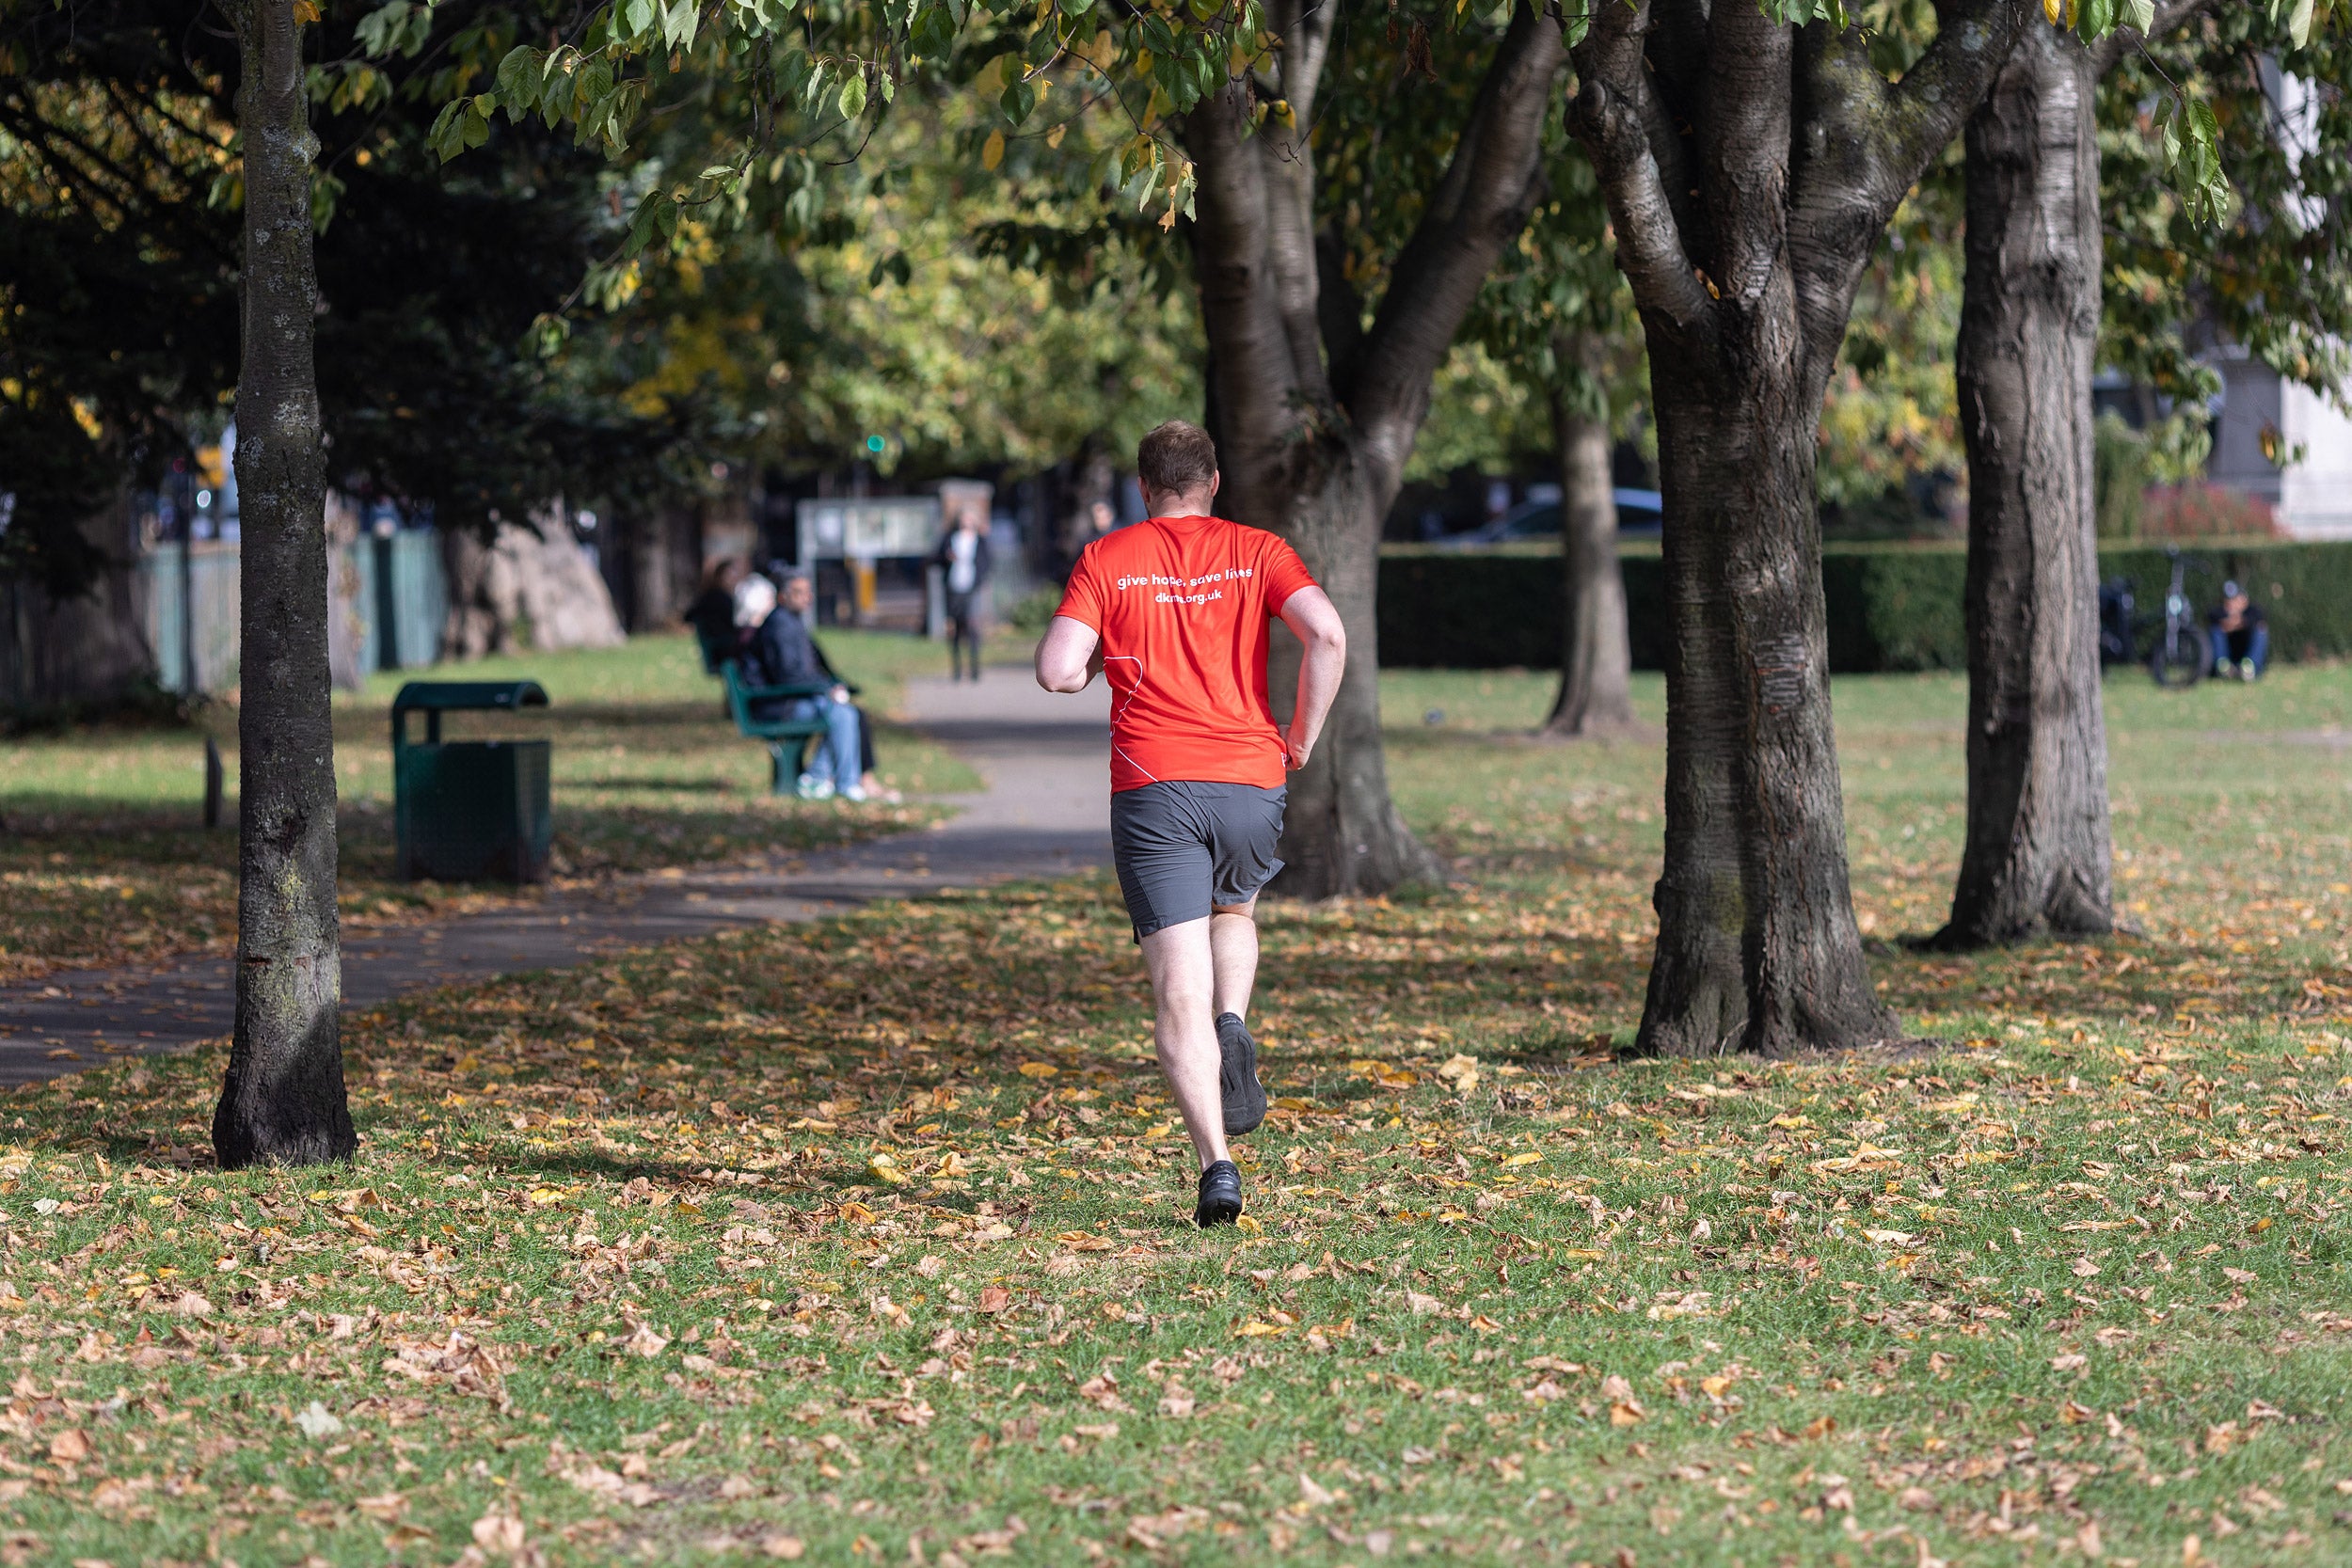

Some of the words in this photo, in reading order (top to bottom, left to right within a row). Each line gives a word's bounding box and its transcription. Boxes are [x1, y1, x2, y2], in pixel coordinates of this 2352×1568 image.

[1117, 574, 1149, 590] give
[1152, 573, 1186, 588] hope,
[1189, 573, 1222, 587] save
[1225, 567, 1253, 580] lives
